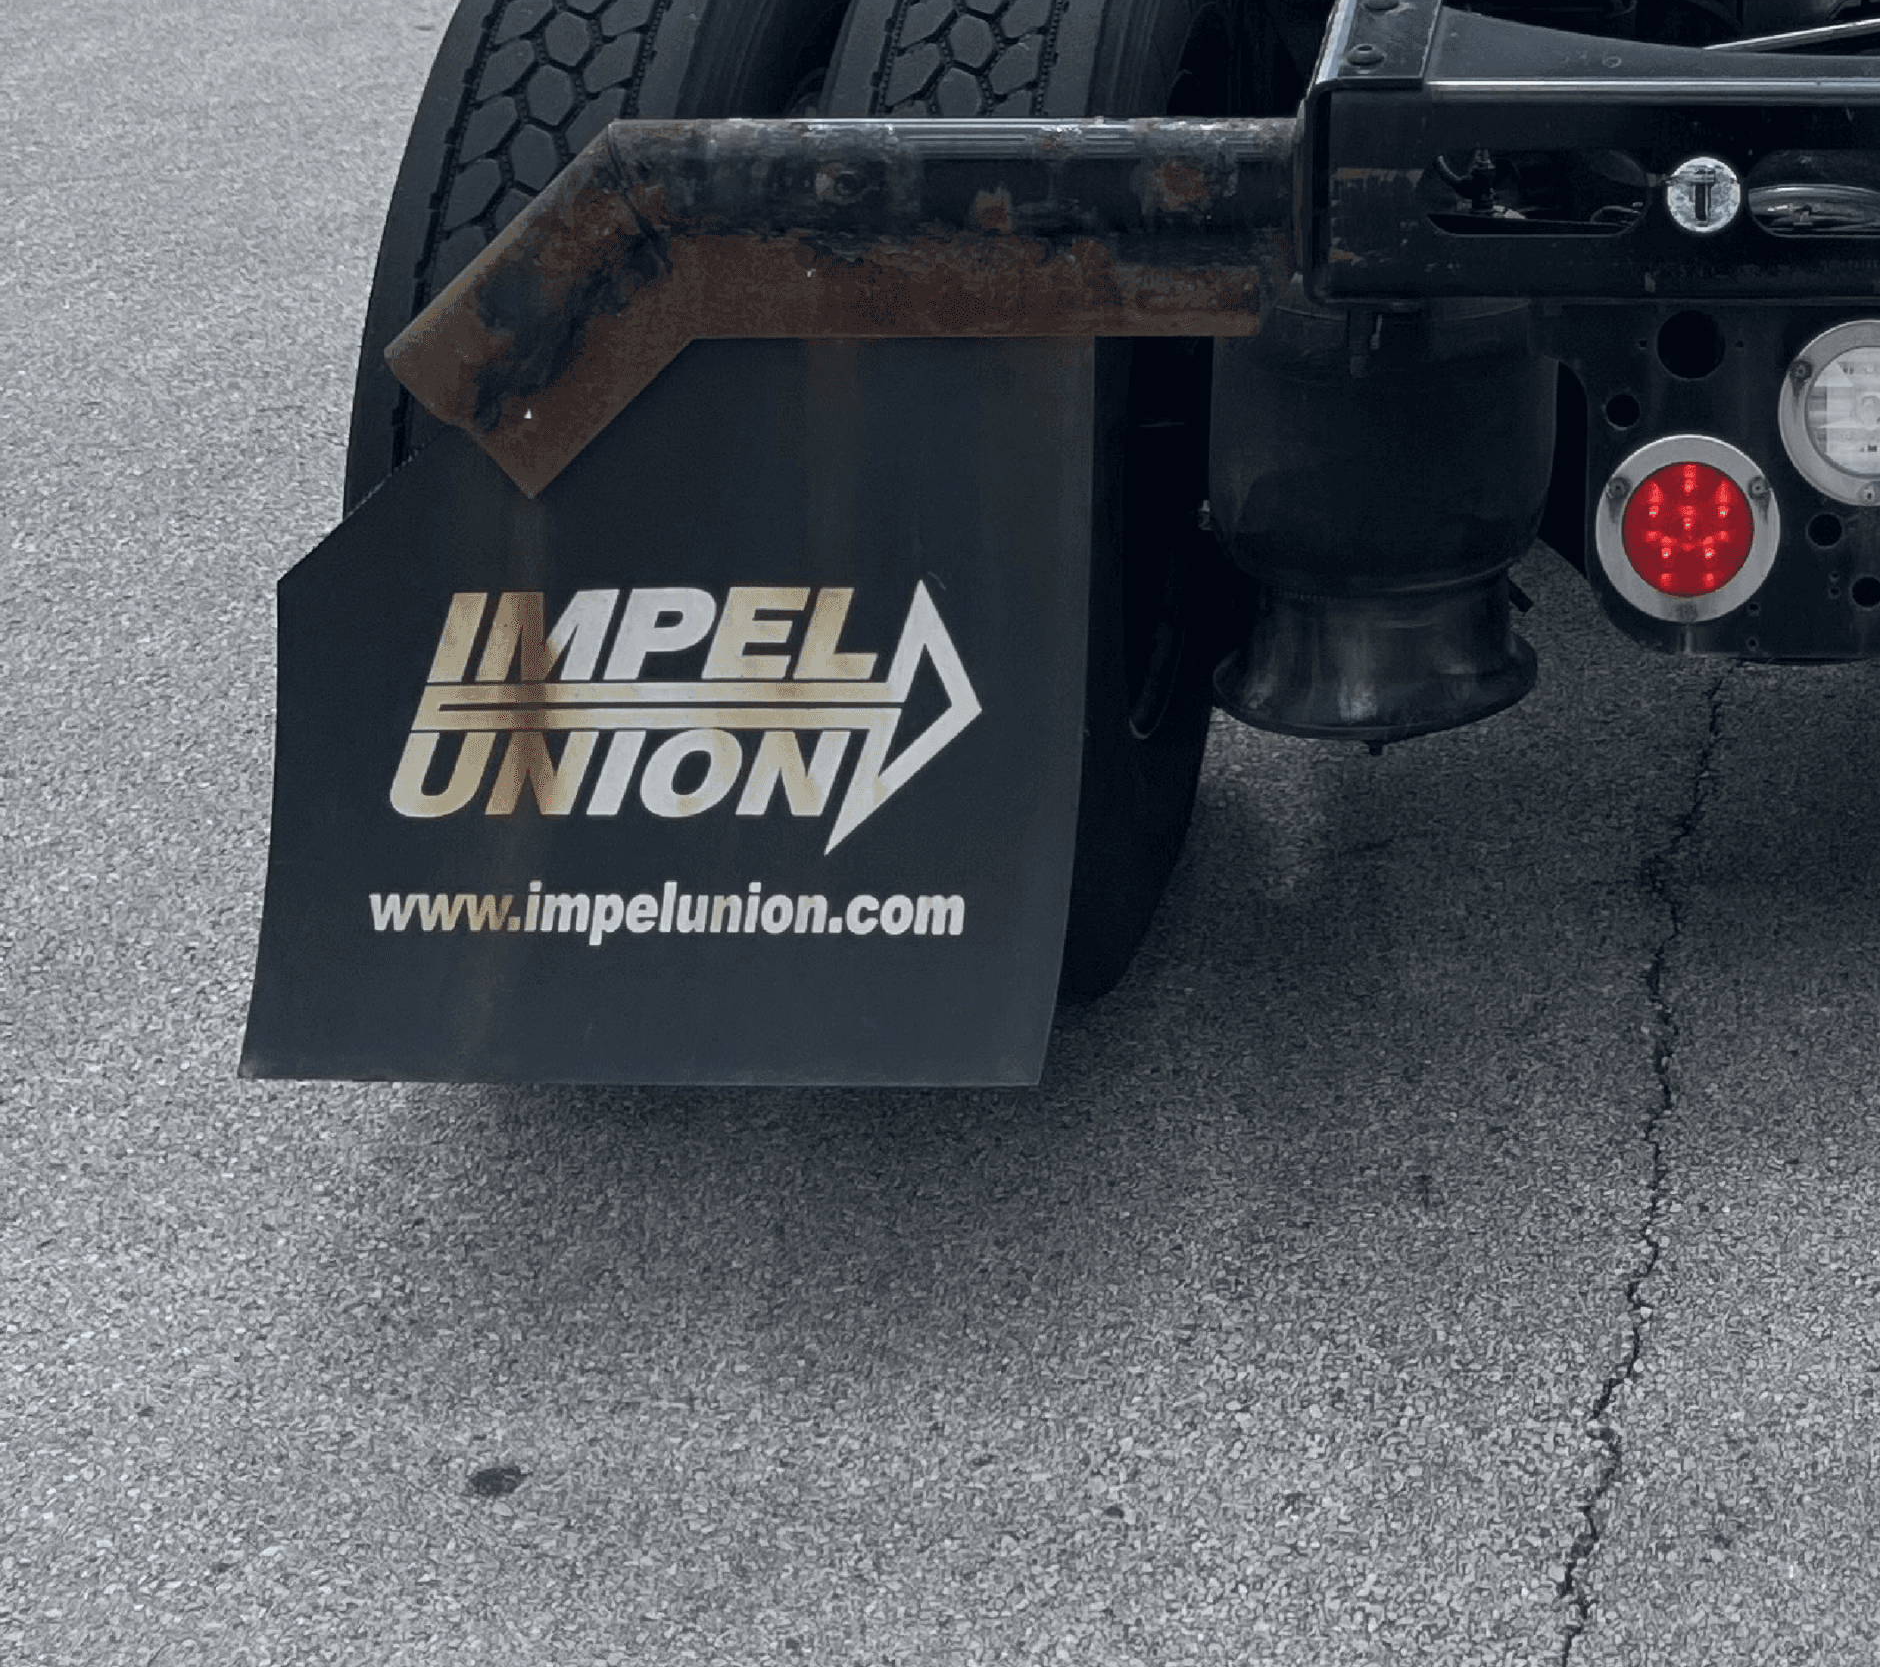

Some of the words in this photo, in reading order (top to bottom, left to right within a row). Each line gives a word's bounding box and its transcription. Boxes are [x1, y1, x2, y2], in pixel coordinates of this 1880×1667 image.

[428, 586, 878, 681] IMPEL
[388, 728, 850, 818] UNION
[369, 881, 965, 946] www.impelunion.com
